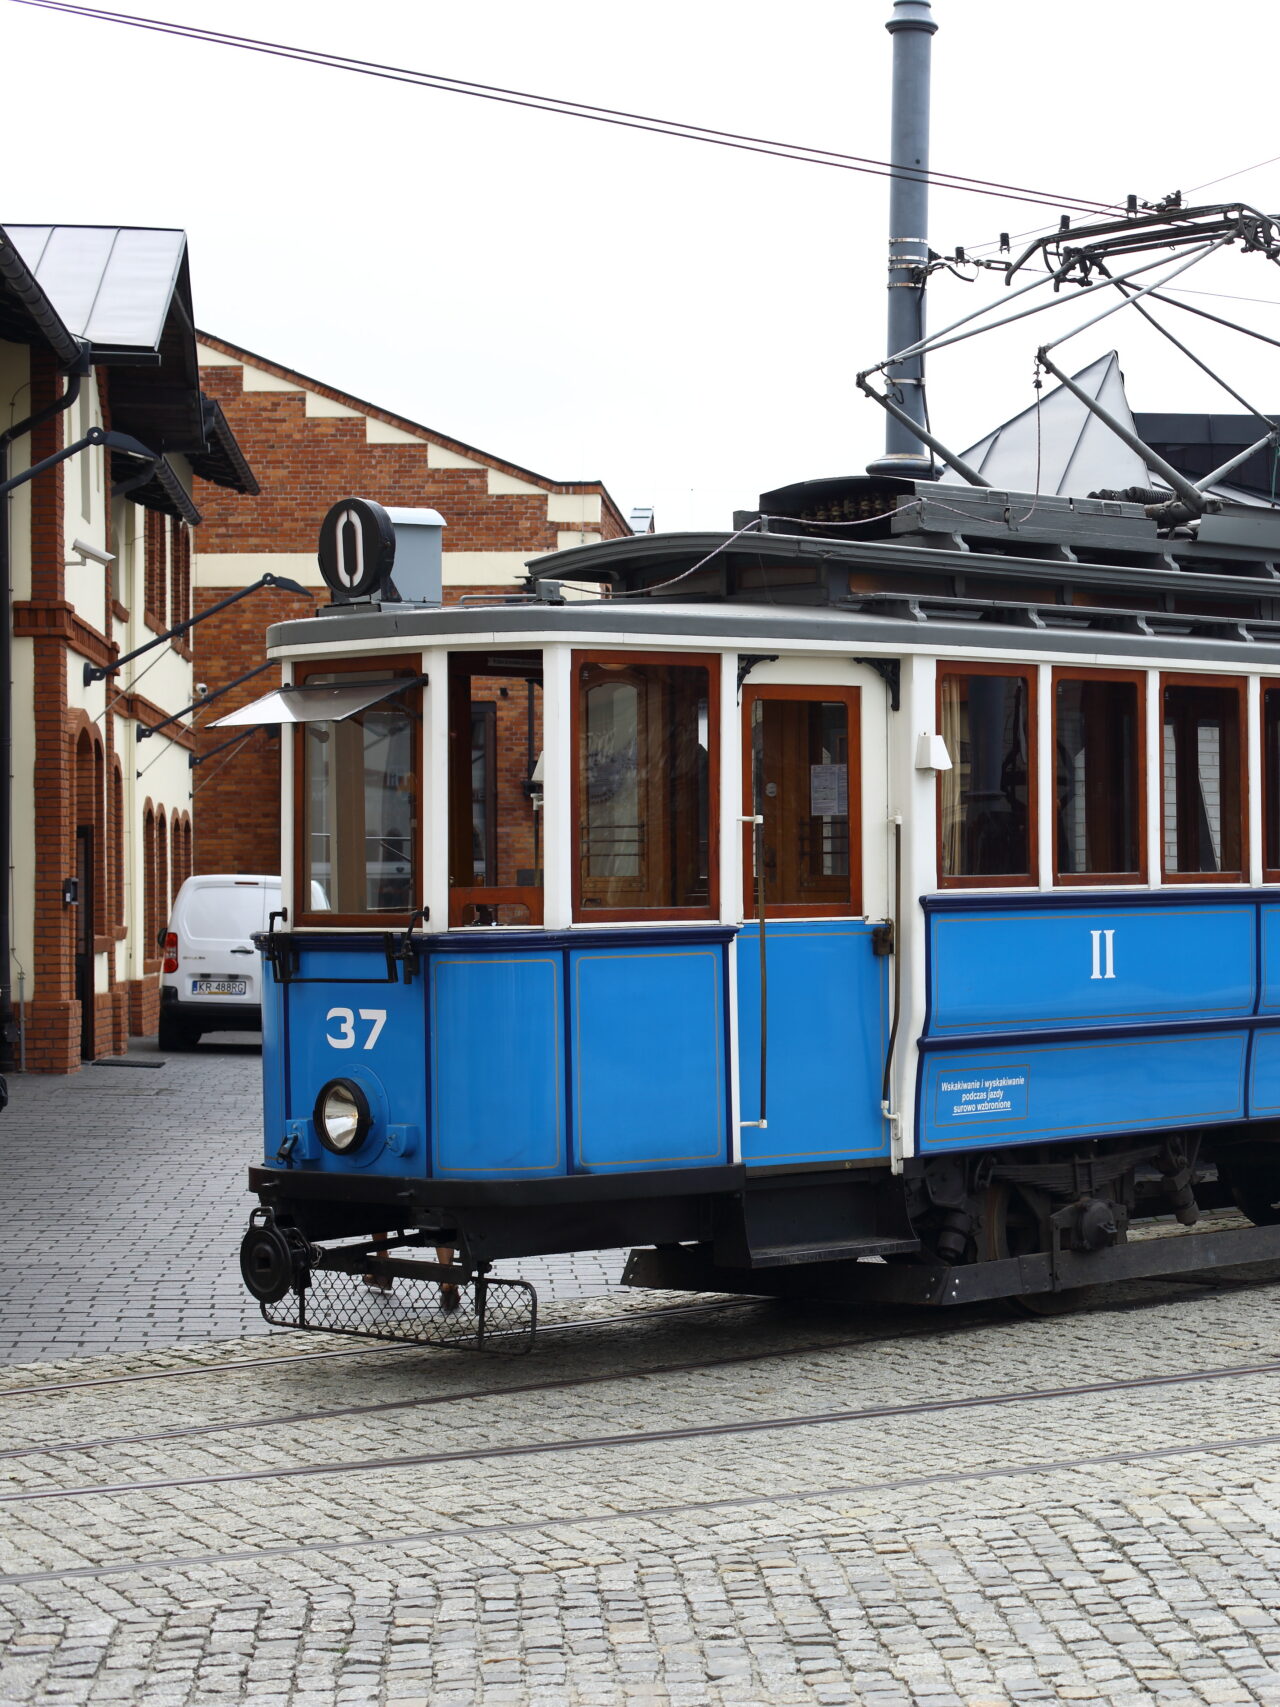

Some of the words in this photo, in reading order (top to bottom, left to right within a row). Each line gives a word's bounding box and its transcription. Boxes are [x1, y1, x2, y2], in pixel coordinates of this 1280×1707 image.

[1090, 929, 1116, 979] II
[199, 983, 212, 992] KR
[215, 983, 243, 992] 488RG
[326, 1007, 387, 1050] 37
[942, 1080, 980, 1091] Wskakiwanie
[984, 1076, 1025, 1089] wyskakiwanie
[961, 1090, 986, 1103] podczas
[987, 1088, 1004, 1101] jazdy
[953, 1104, 976, 1113] surowo
[977, 1099, 1011, 1111] wzbronione
